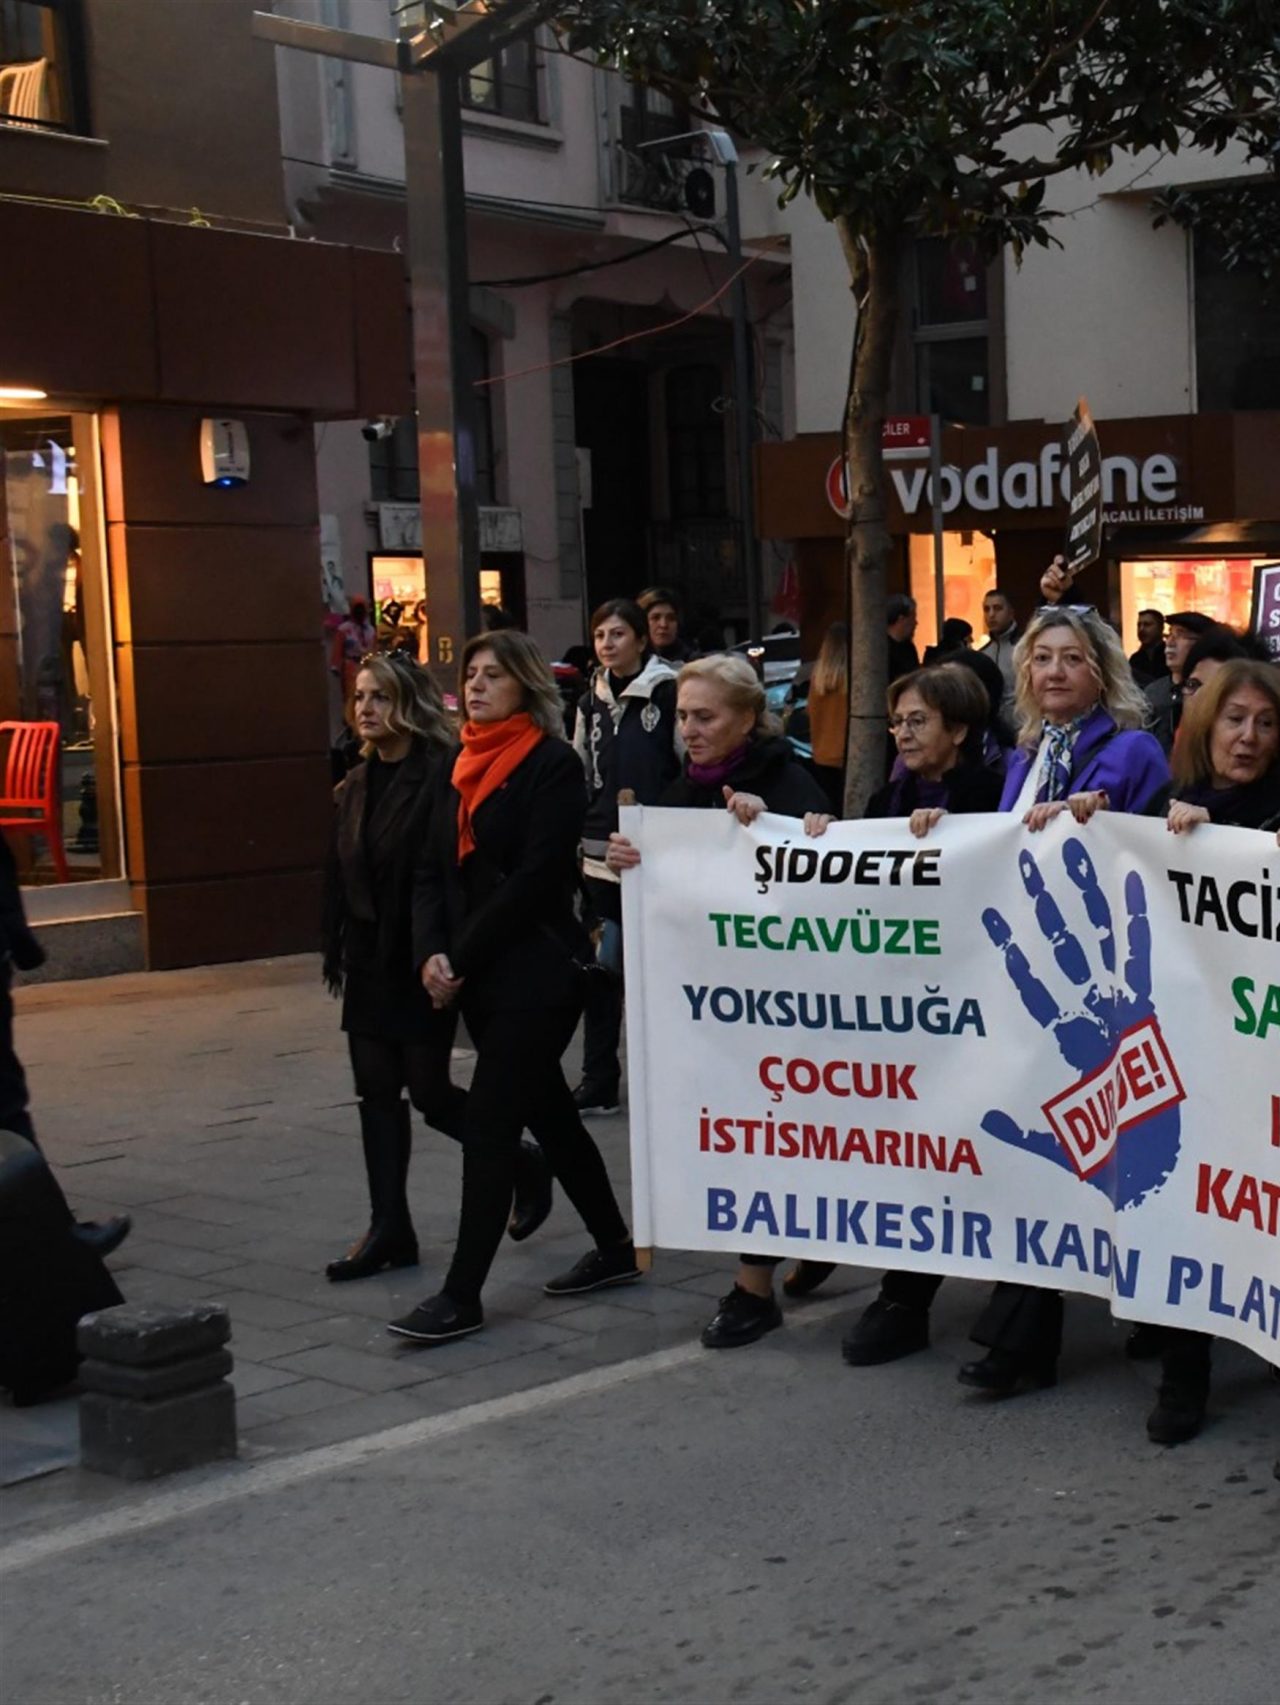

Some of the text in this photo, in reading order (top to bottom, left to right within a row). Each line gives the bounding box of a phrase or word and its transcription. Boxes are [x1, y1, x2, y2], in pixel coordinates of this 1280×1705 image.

[1143, 503, 1204, 523] İLETİŞİM
[755, 841, 942, 894] ŞİDDETE
[709, 909, 942, 955] TECAVÜZE
[682, 984, 987, 1037] YOKSULLUĞA
[759, 1056, 918, 1102] ÇOCUK
[699, 1107, 983, 1176] İSTİSMARINA
[707, 1188, 993, 1260] BALIKESİR
